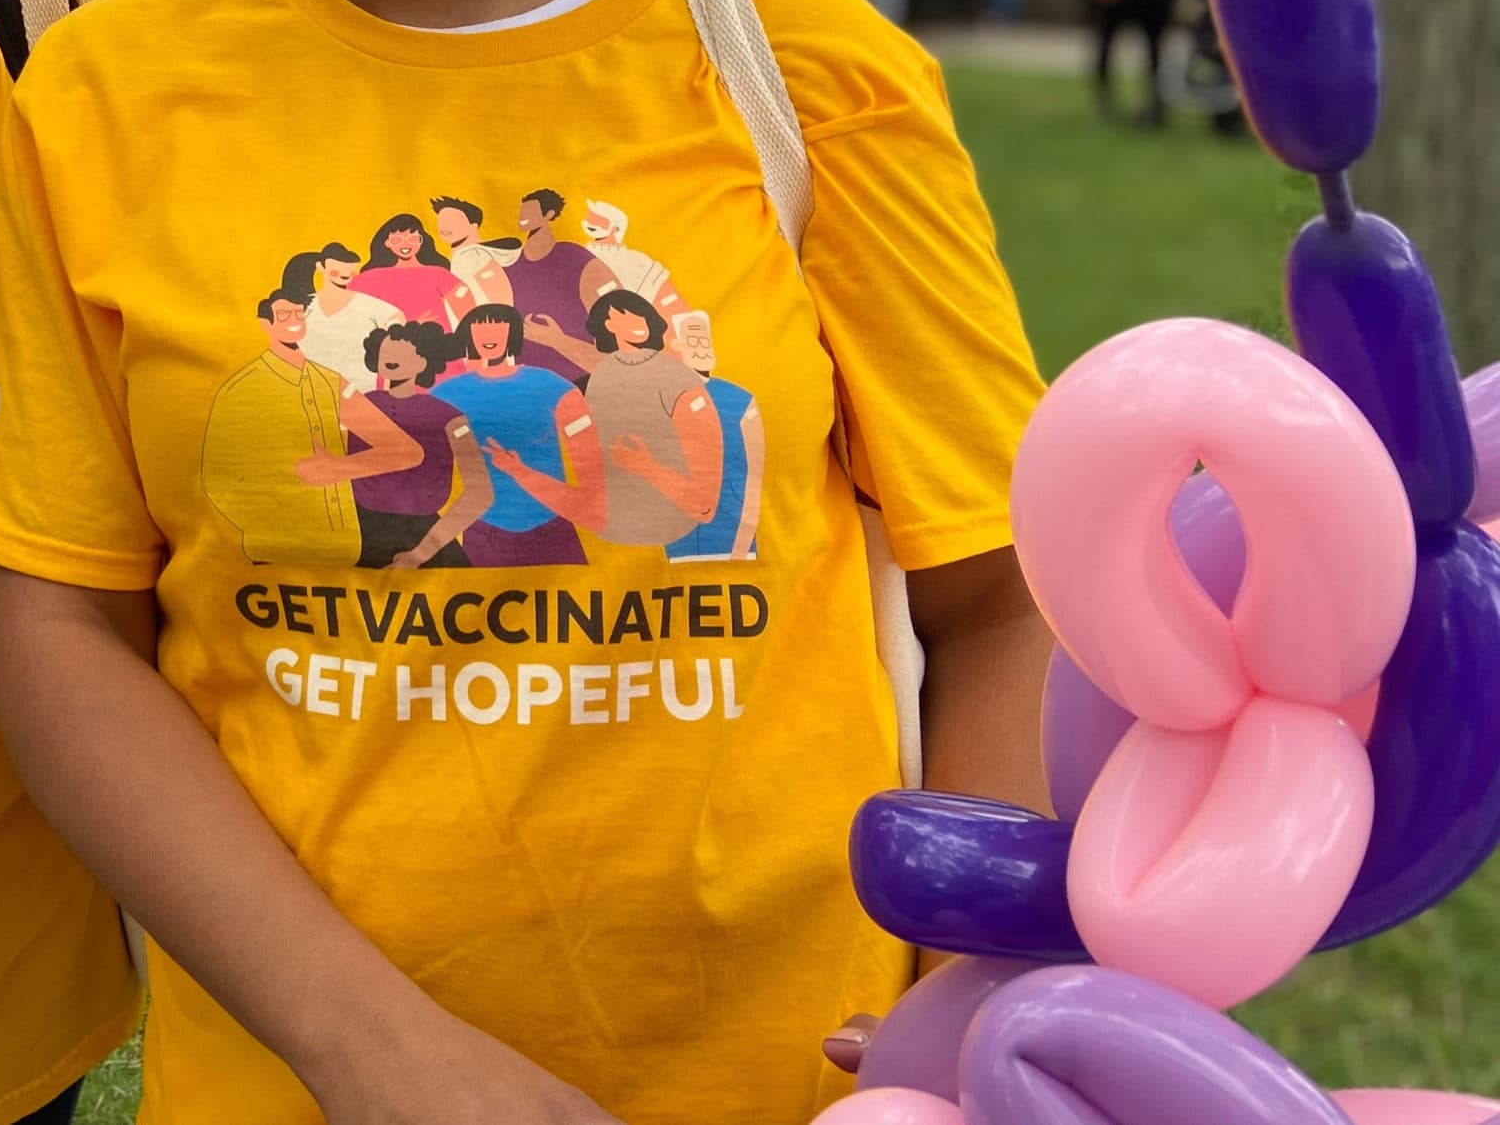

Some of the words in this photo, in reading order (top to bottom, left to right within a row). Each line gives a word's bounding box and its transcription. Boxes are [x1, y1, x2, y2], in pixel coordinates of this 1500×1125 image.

[235, 583, 347, 637] GET
[357, 584, 768, 646] VACCINATED
[265, 647, 377, 721] GET
[396, 657, 744, 725] HOPEFUL
